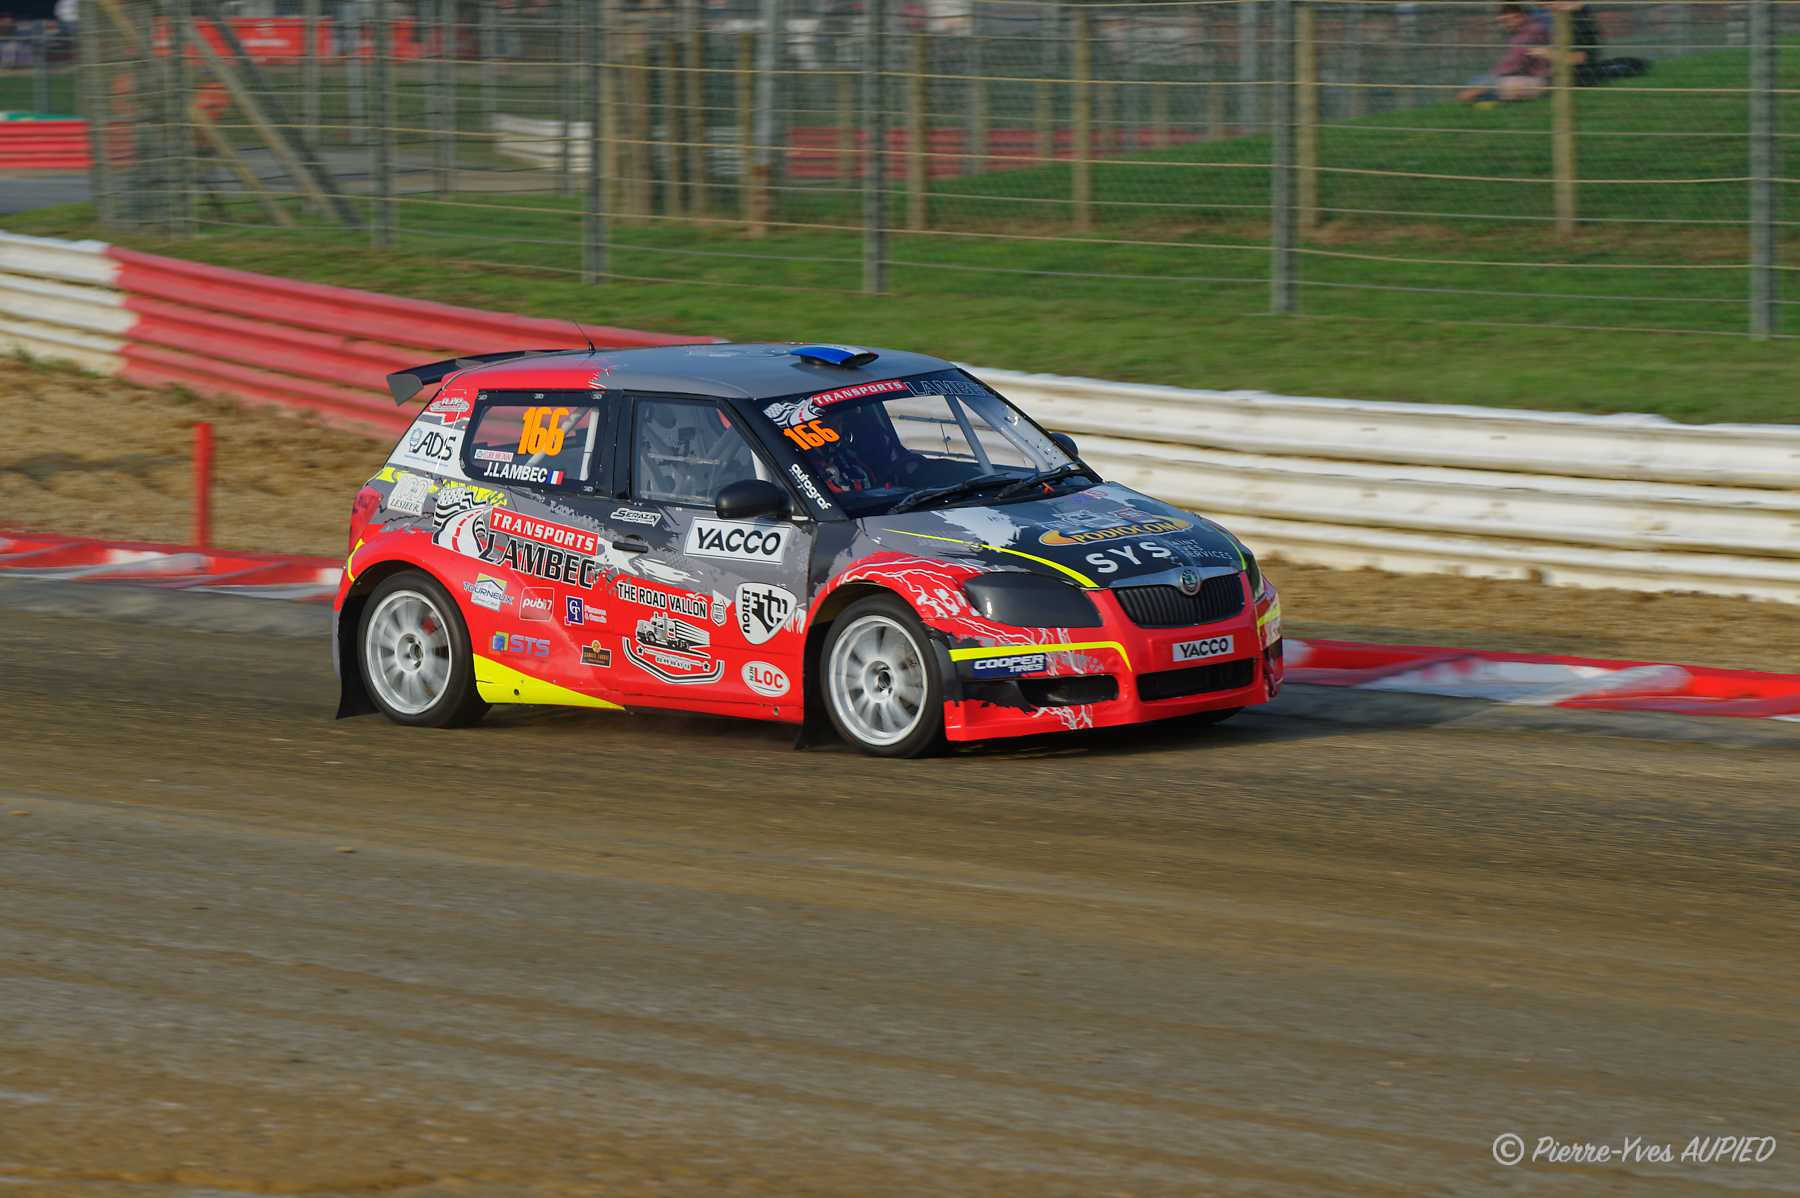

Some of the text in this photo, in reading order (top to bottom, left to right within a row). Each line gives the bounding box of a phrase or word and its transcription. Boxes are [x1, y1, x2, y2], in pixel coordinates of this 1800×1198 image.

[814, 381, 902, 405] TRANSPORTS
[517, 405, 569, 457] 166
[783, 419, 841, 451] 166
[483, 461, 548, 483] J.LAMBEC
[790, 463, 832, 510] autograf
[493, 512, 595, 551] TRANSPORTS
[697, 527, 782, 556] YACCO
[479, 531, 596, 590] LAMBEC
[1086, 541, 1172, 573] SYS
[617, 583, 636, 601] THE
[638, 587, 667, 609] ROAD
[669, 595, 708, 619] VALLON
[511, 634, 551, 656] STS
[1180, 638, 1228, 658] YACCO
[974, 654, 1045, 670] COOPER
[754, 667, 784, 689] LOC
